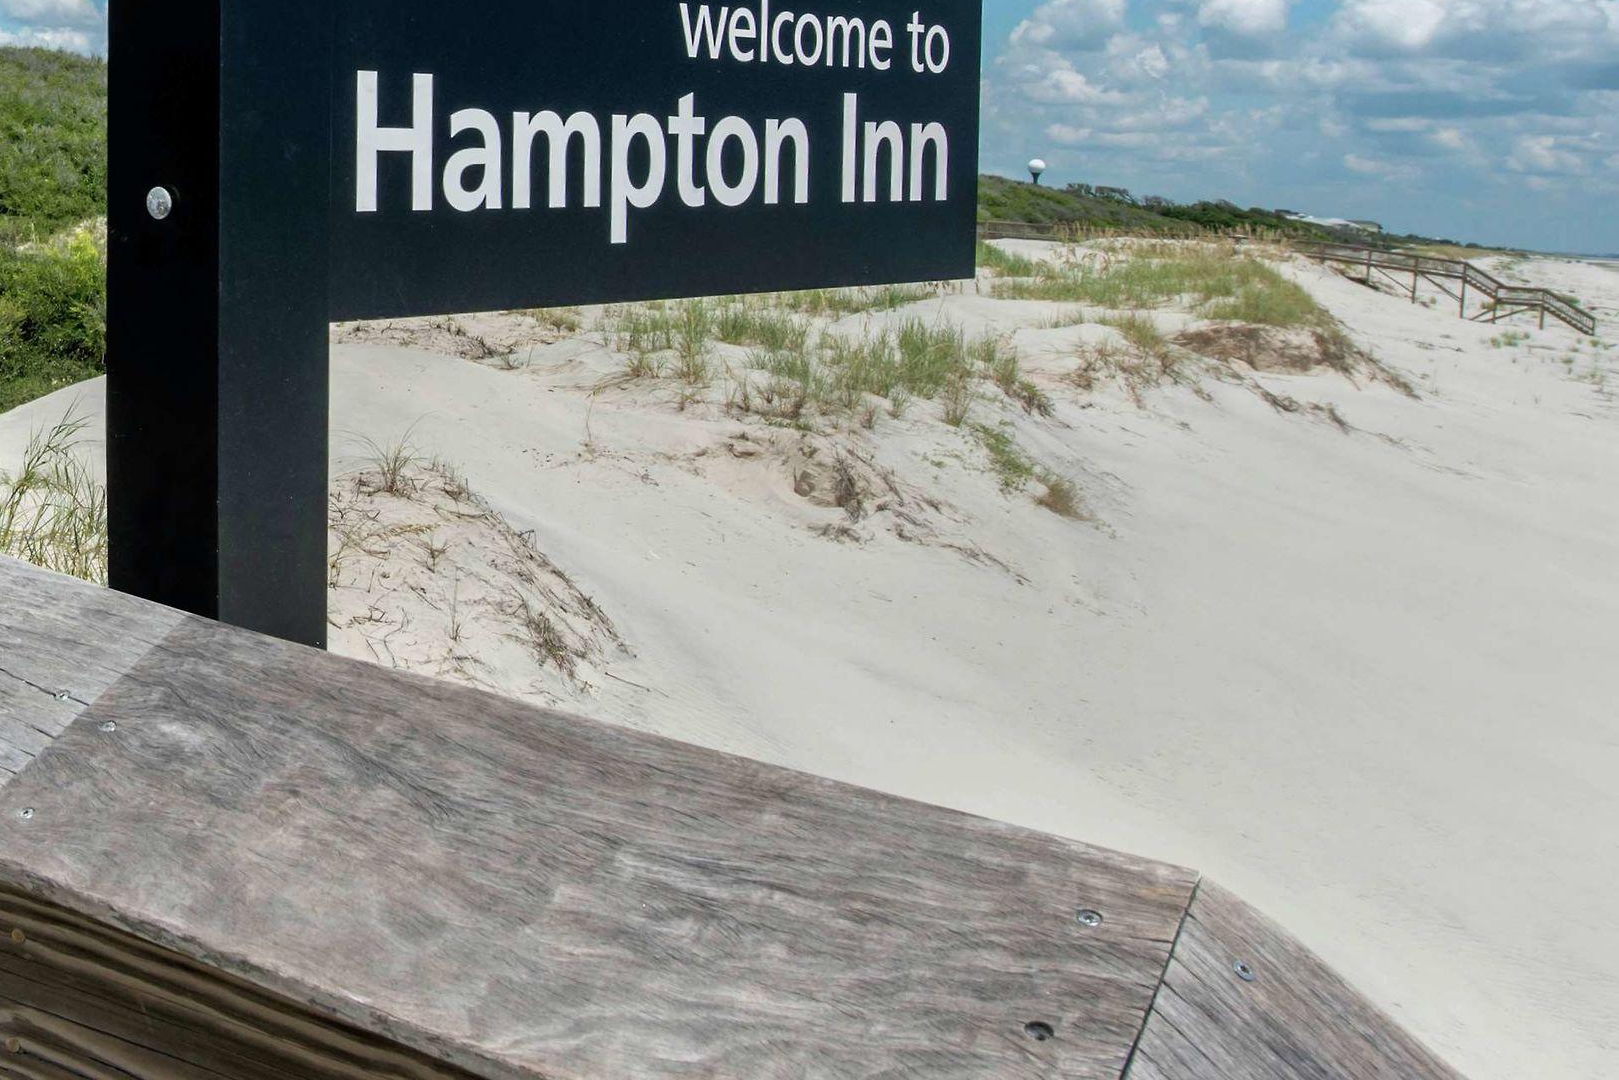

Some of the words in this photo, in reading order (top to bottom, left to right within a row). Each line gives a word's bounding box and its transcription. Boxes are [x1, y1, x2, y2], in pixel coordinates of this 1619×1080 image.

[906, 10, 950, 74] to
[355, 69, 809, 244] Hampton
[841, 92, 948, 203] Inn
